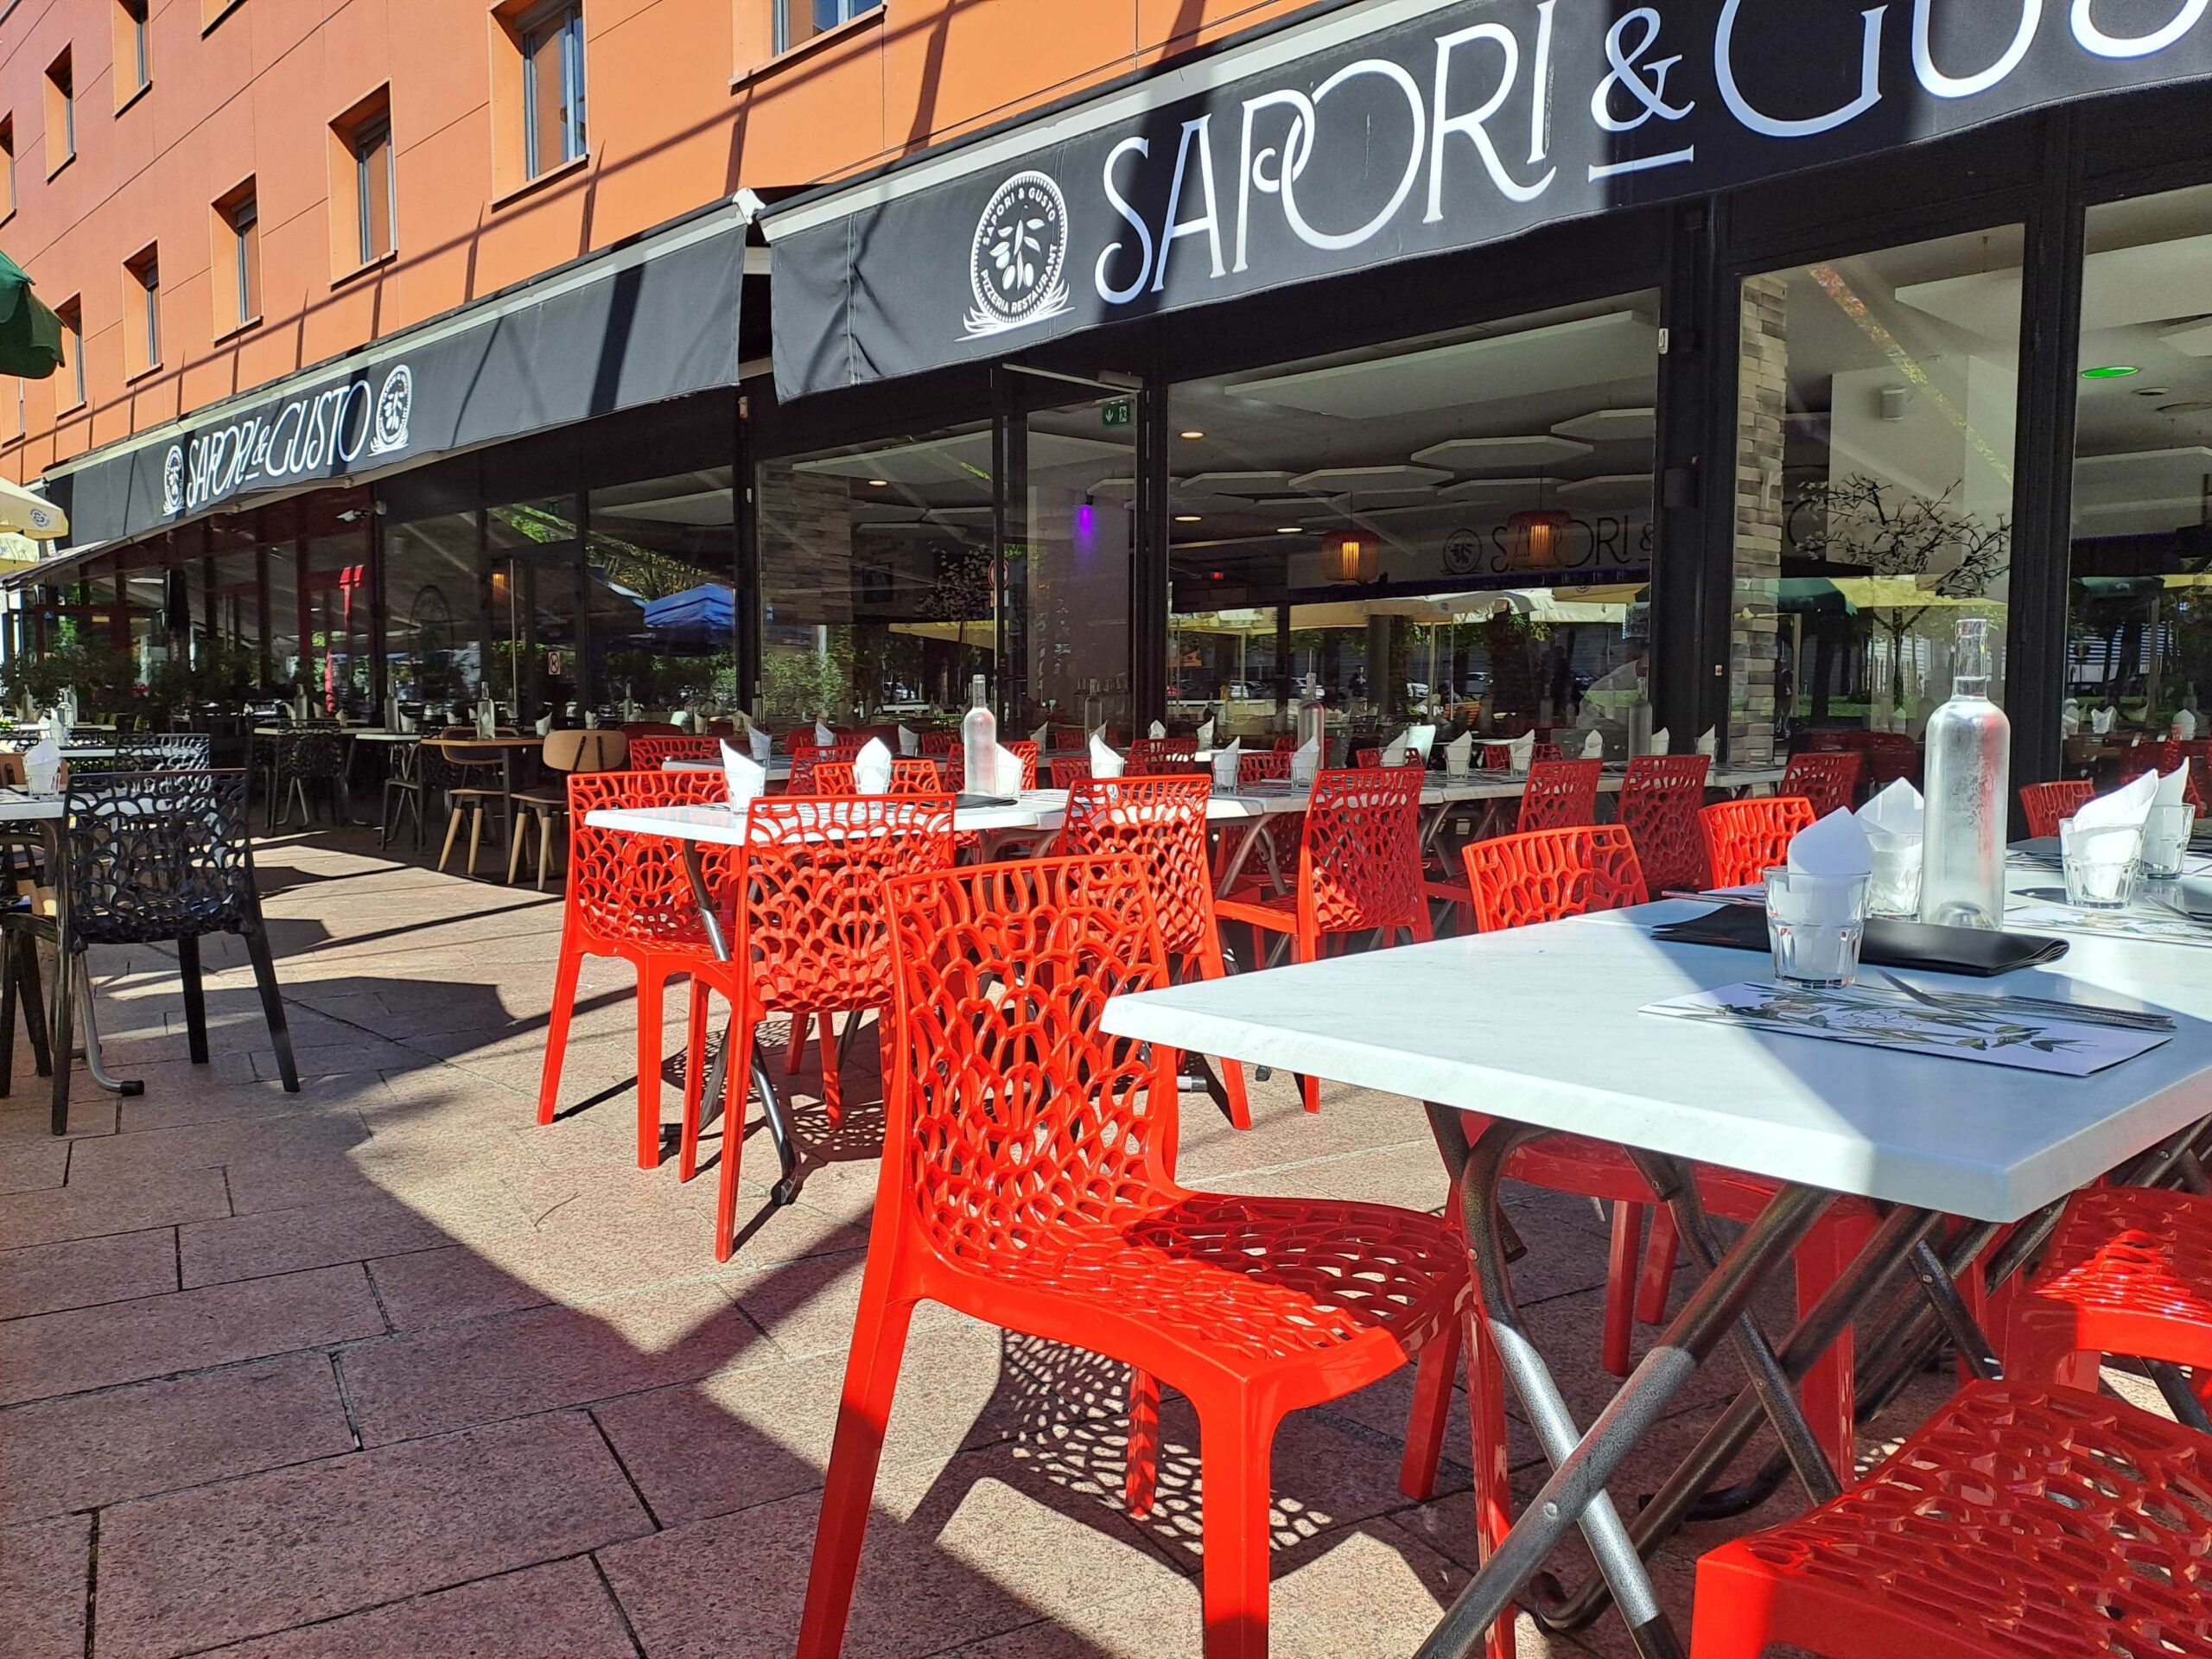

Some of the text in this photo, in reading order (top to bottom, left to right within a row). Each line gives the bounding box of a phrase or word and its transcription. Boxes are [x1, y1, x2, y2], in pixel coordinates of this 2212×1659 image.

[1094, 0, 1557, 304] SAPORI
[1590, 7, 1696, 134] &
[982, 187, 1057, 246] SAPORI & GUSTO
[980, 243, 1058, 314] PIZZERIA RESTAURANT
[187, 379, 372, 509] SAPORI & GUSTO
